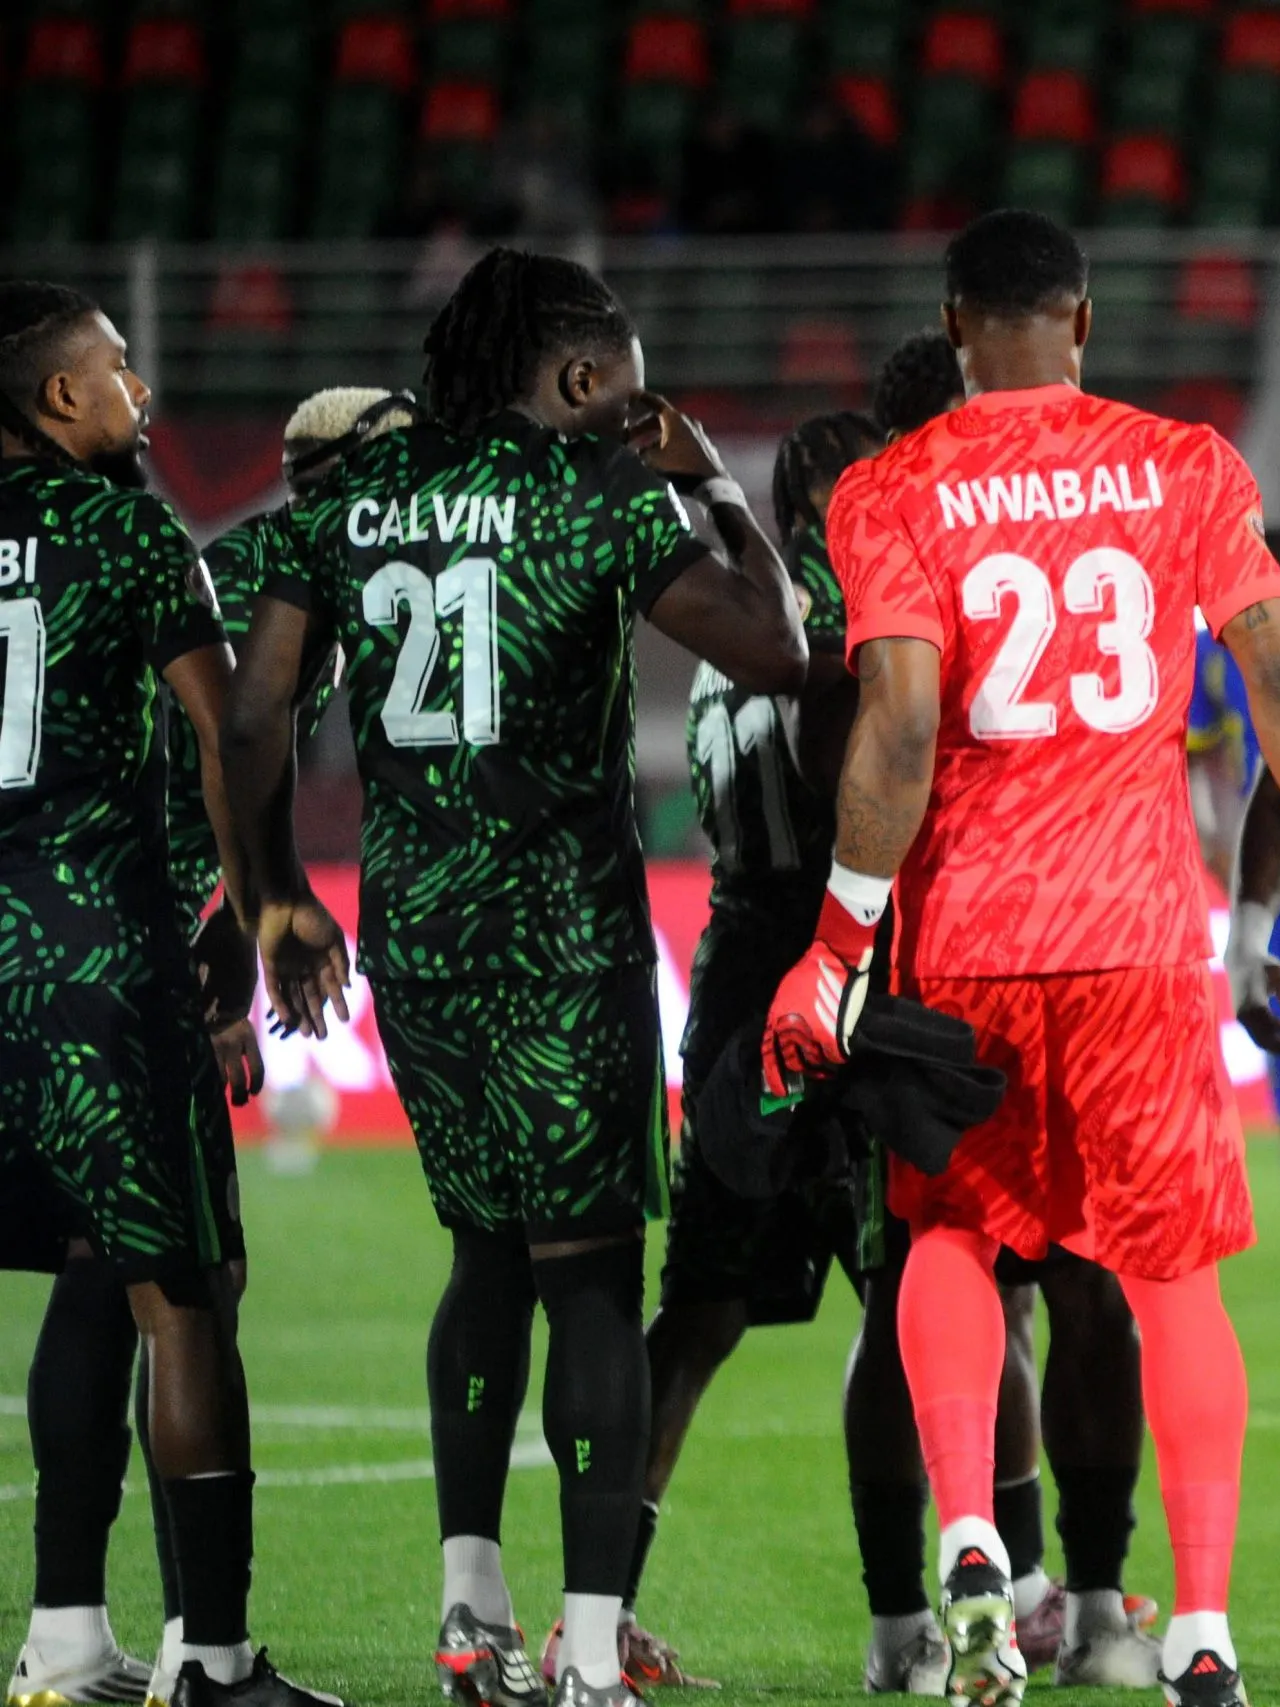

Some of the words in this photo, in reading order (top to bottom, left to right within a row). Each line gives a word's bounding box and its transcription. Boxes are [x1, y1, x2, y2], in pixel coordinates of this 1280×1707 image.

[347, 494, 516, 547] CALVIN
[936, 459, 1164, 530] NWABALI
[363, 559, 499, 746] 21
[963, 548, 1156, 739] 23
